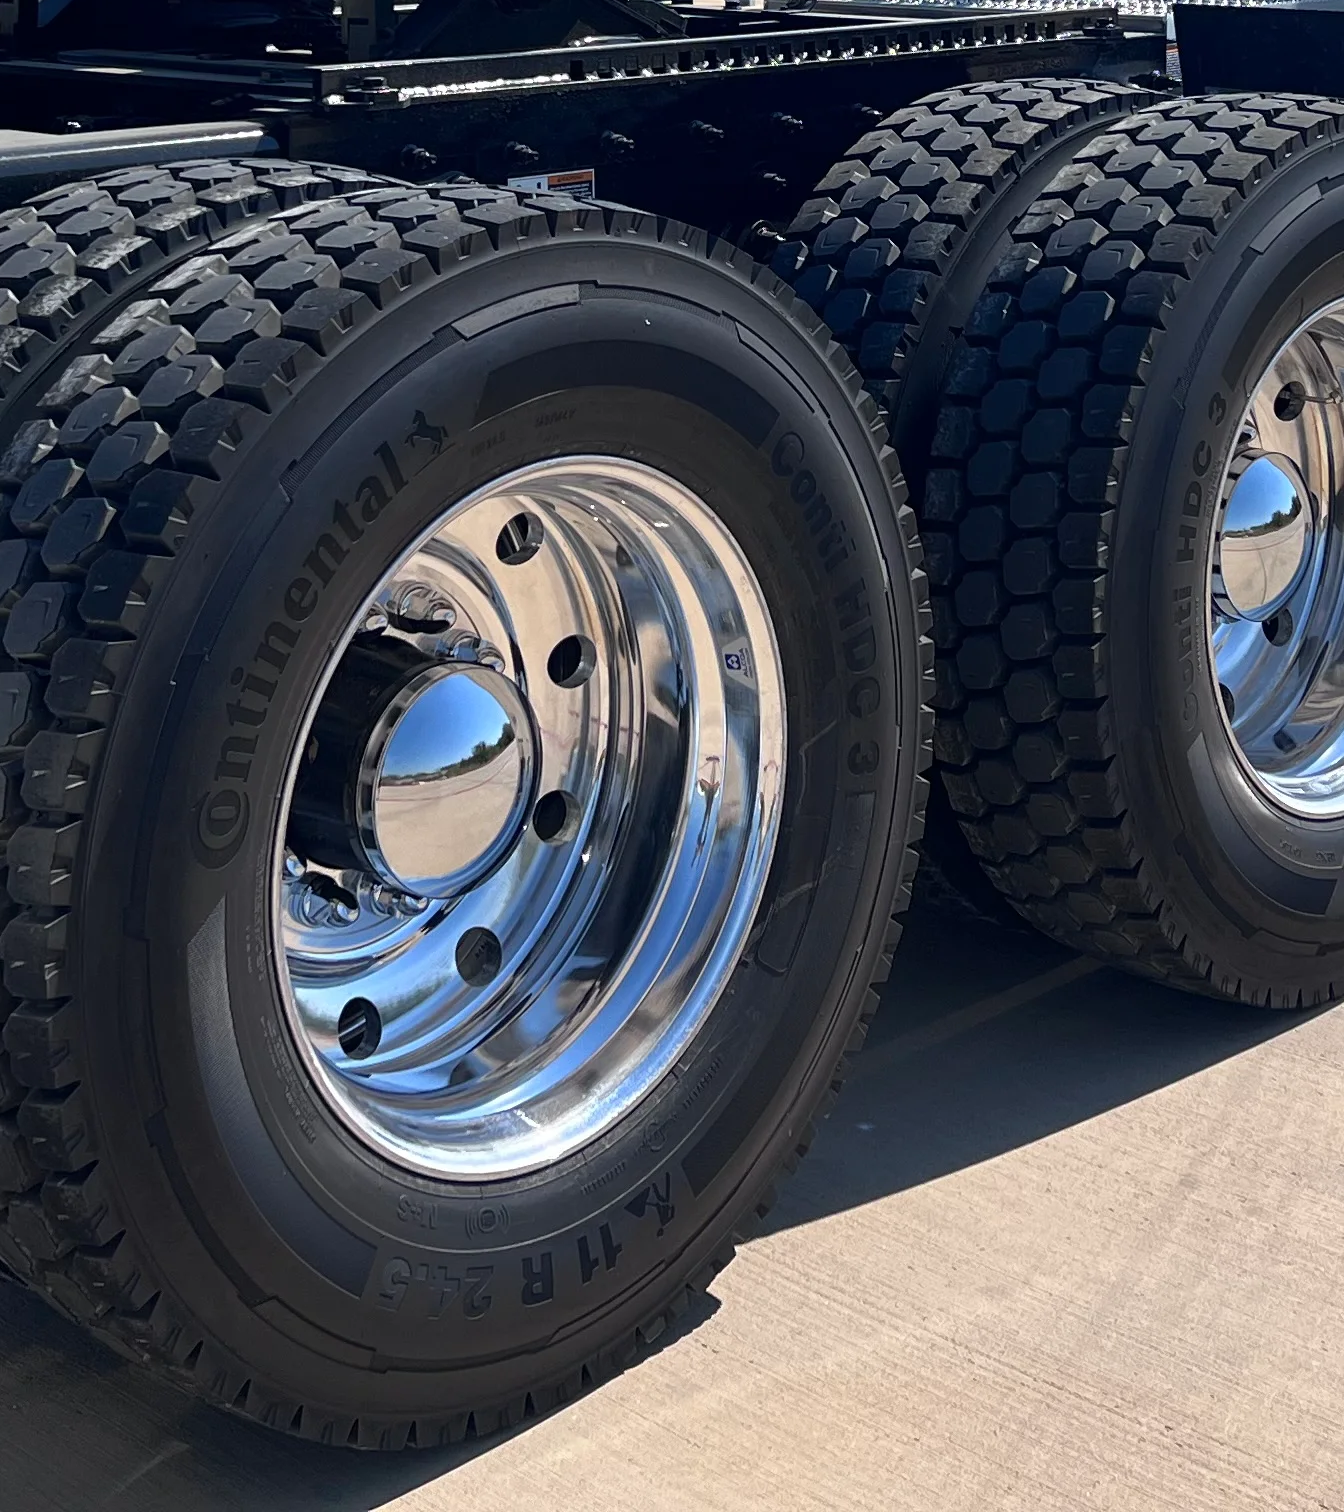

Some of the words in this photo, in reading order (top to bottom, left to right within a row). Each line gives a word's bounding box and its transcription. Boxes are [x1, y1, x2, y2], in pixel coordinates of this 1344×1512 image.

[1208, 391, 1227, 427] 3
[770, 431, 857, 575] Conti
[1177, 439, 1211, 564] HDC
[191, 440, 410, 870] Continental
[833, 577, 882, 719] HDC
[1172, 584, 1199, 732] Conti
[847, 740, 881, 776] 3
[373, 1255, 495, 1321] 24.5
[519, 1252, 554, 1307] R
[576, 1222, 623, 1285] 11
